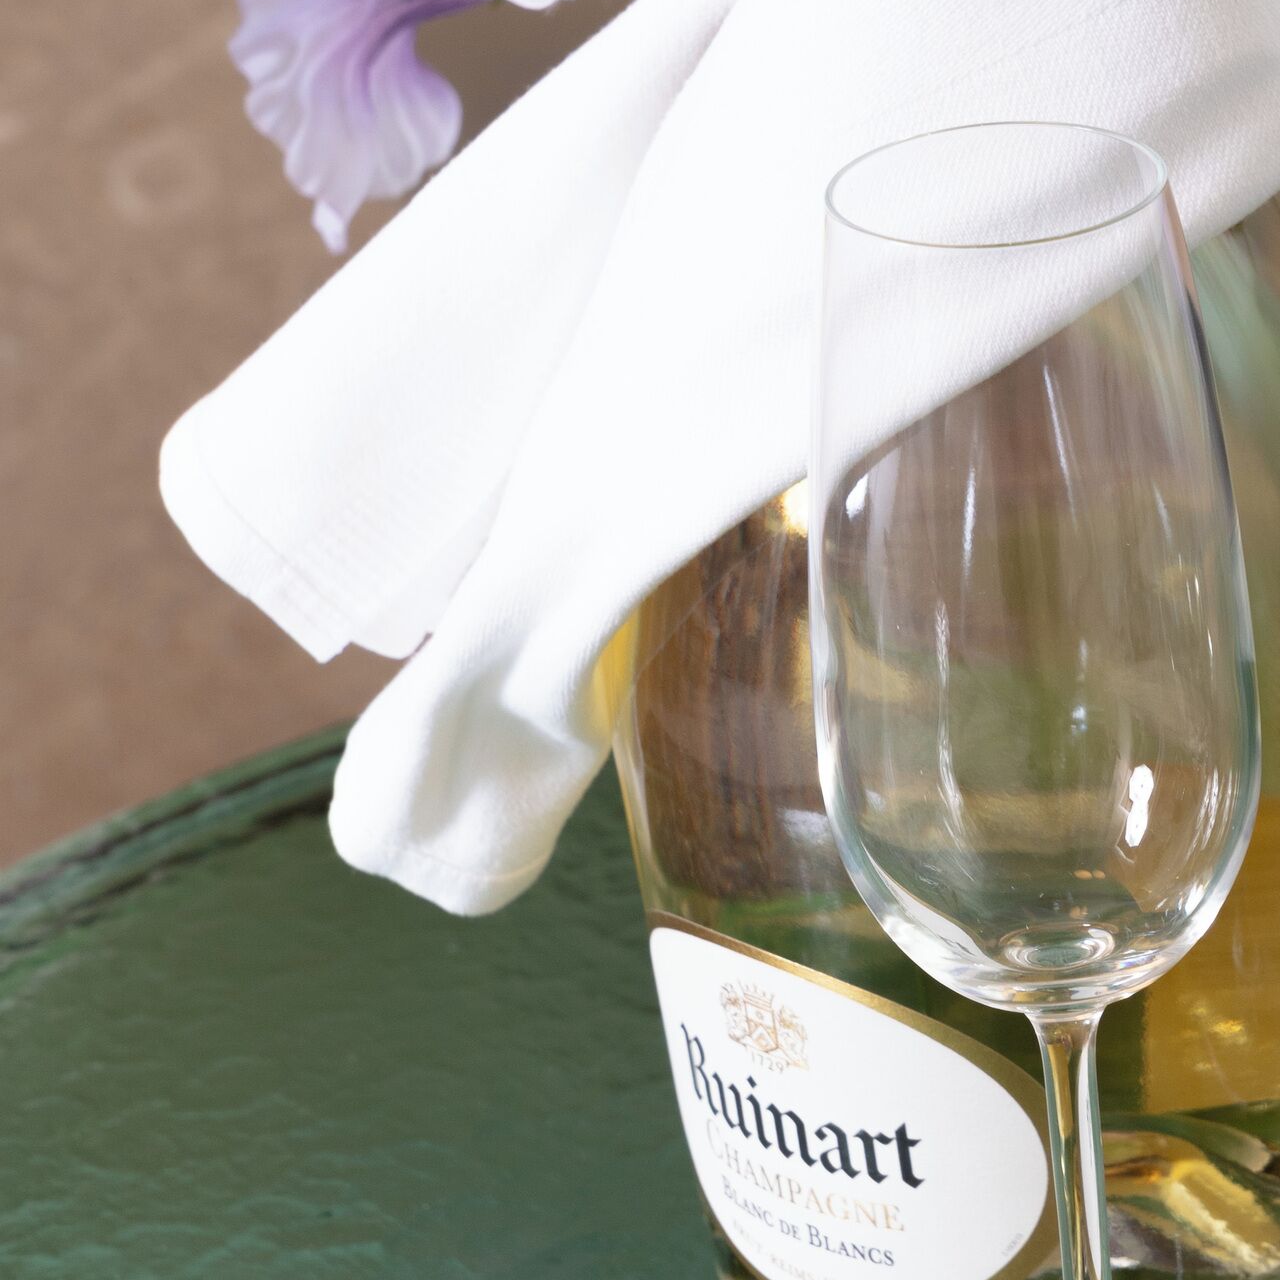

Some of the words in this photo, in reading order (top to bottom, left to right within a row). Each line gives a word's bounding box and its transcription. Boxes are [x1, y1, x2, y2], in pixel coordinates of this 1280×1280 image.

[680, 1023, 926, 1189] Ruinart
[750, 1052, 785, 1074] 1729
[705, 1118, 906, 1232] CHAMPAGNE
[721, 1175, 775, 1227] BLANC
[806, 1222, 896, 1267] BLANCS
